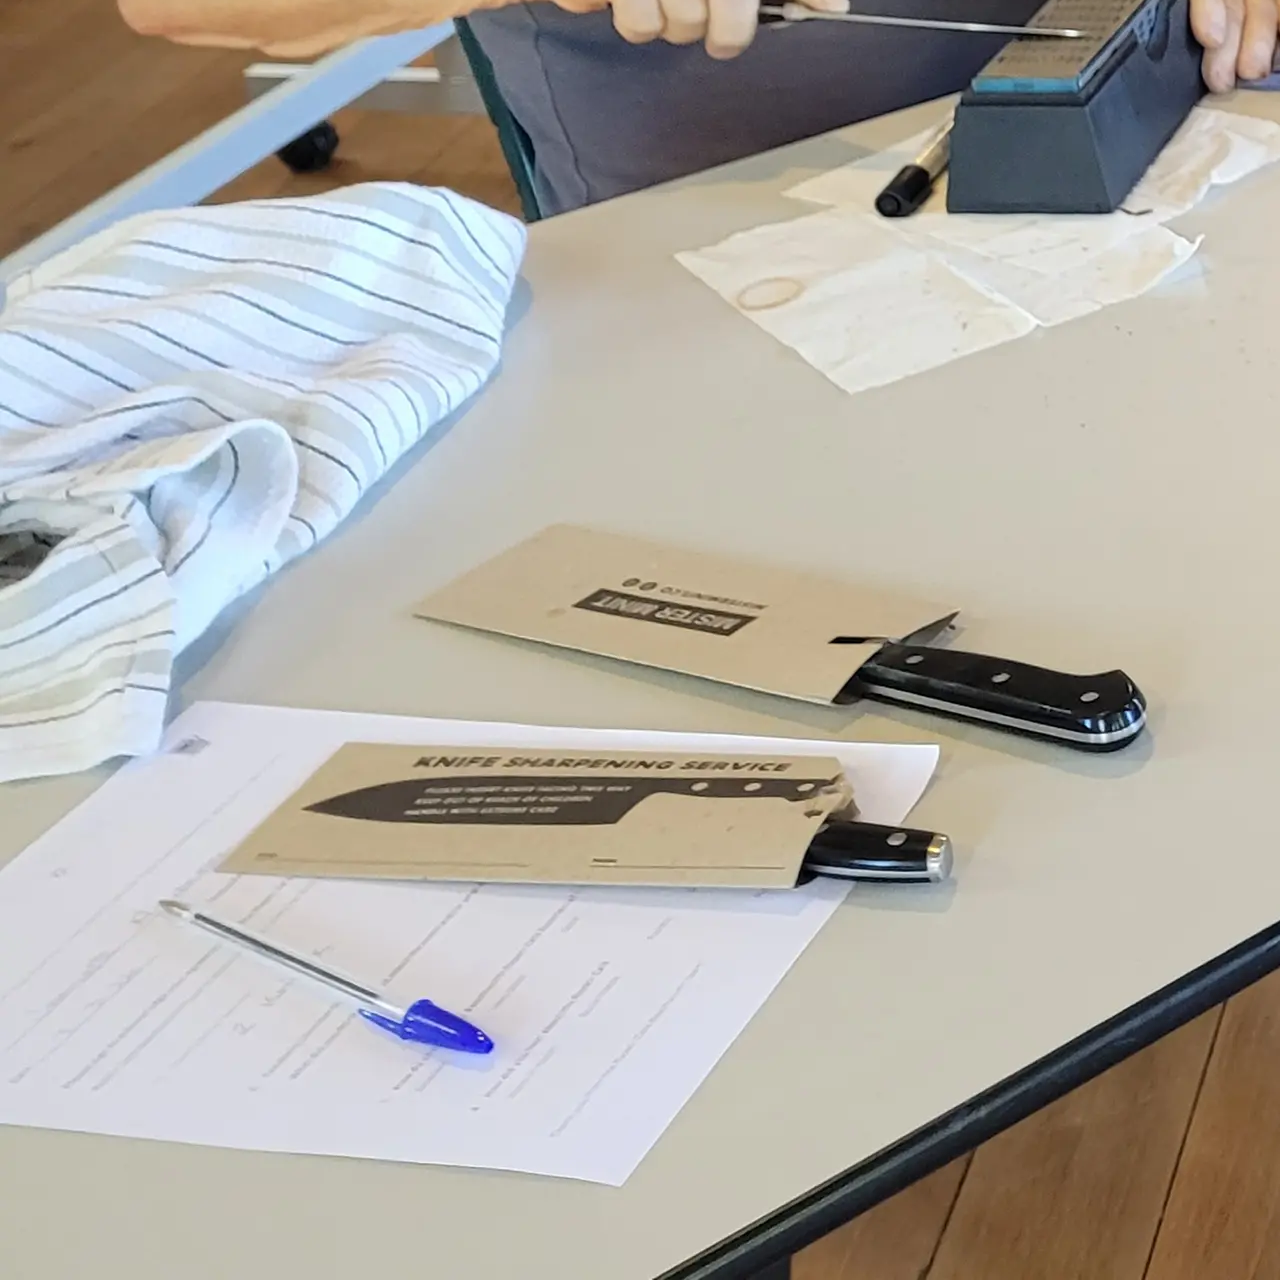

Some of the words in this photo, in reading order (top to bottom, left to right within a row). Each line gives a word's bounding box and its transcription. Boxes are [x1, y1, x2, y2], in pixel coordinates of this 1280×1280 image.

[655, 606, 740, 630] MISTER
[413, 756, 502, 768] KNIFE
[502, 757, 676, 770] SHARPENING
[679, 760, 793, 772] SERVICE
